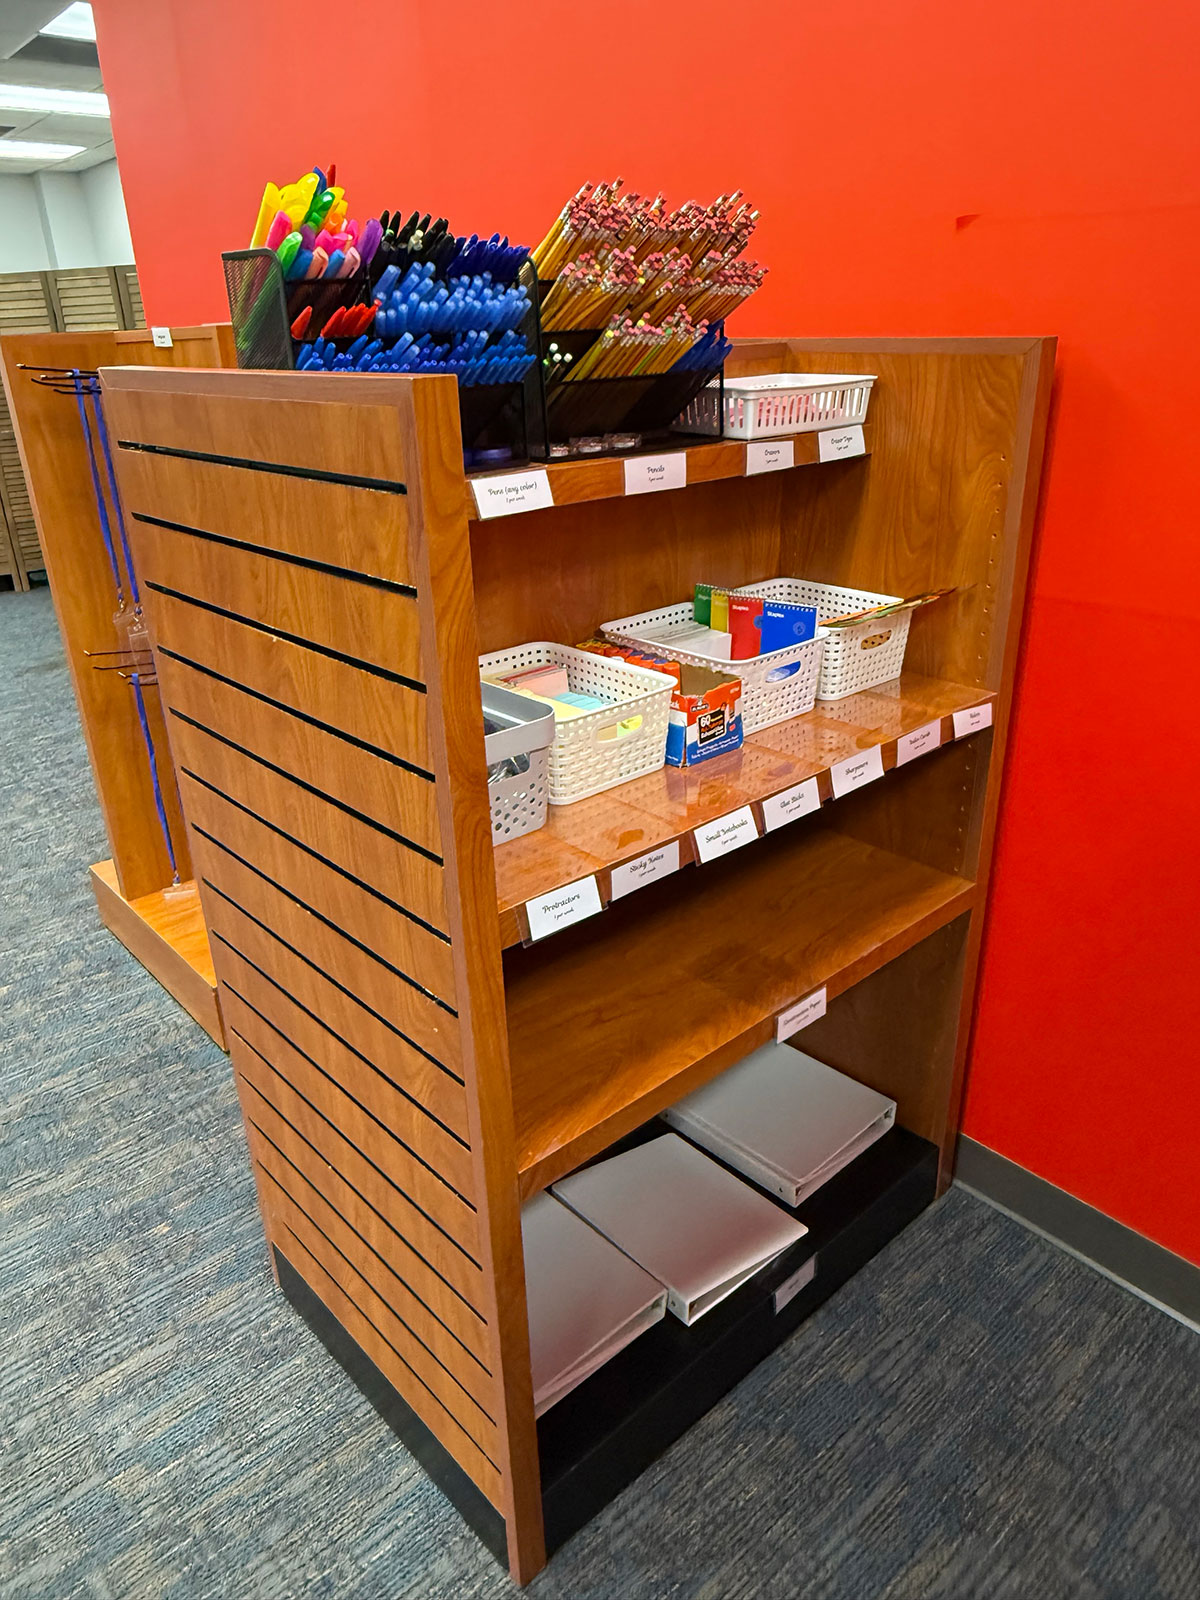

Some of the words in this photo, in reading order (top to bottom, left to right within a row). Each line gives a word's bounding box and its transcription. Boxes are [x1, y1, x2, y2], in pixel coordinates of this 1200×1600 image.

[647, 465, 665, 473] Pencils
[488, 488, 504, 496] Pens
[705, 830, 721, 844] Small
[541, 894, 580, 914] Protractors
